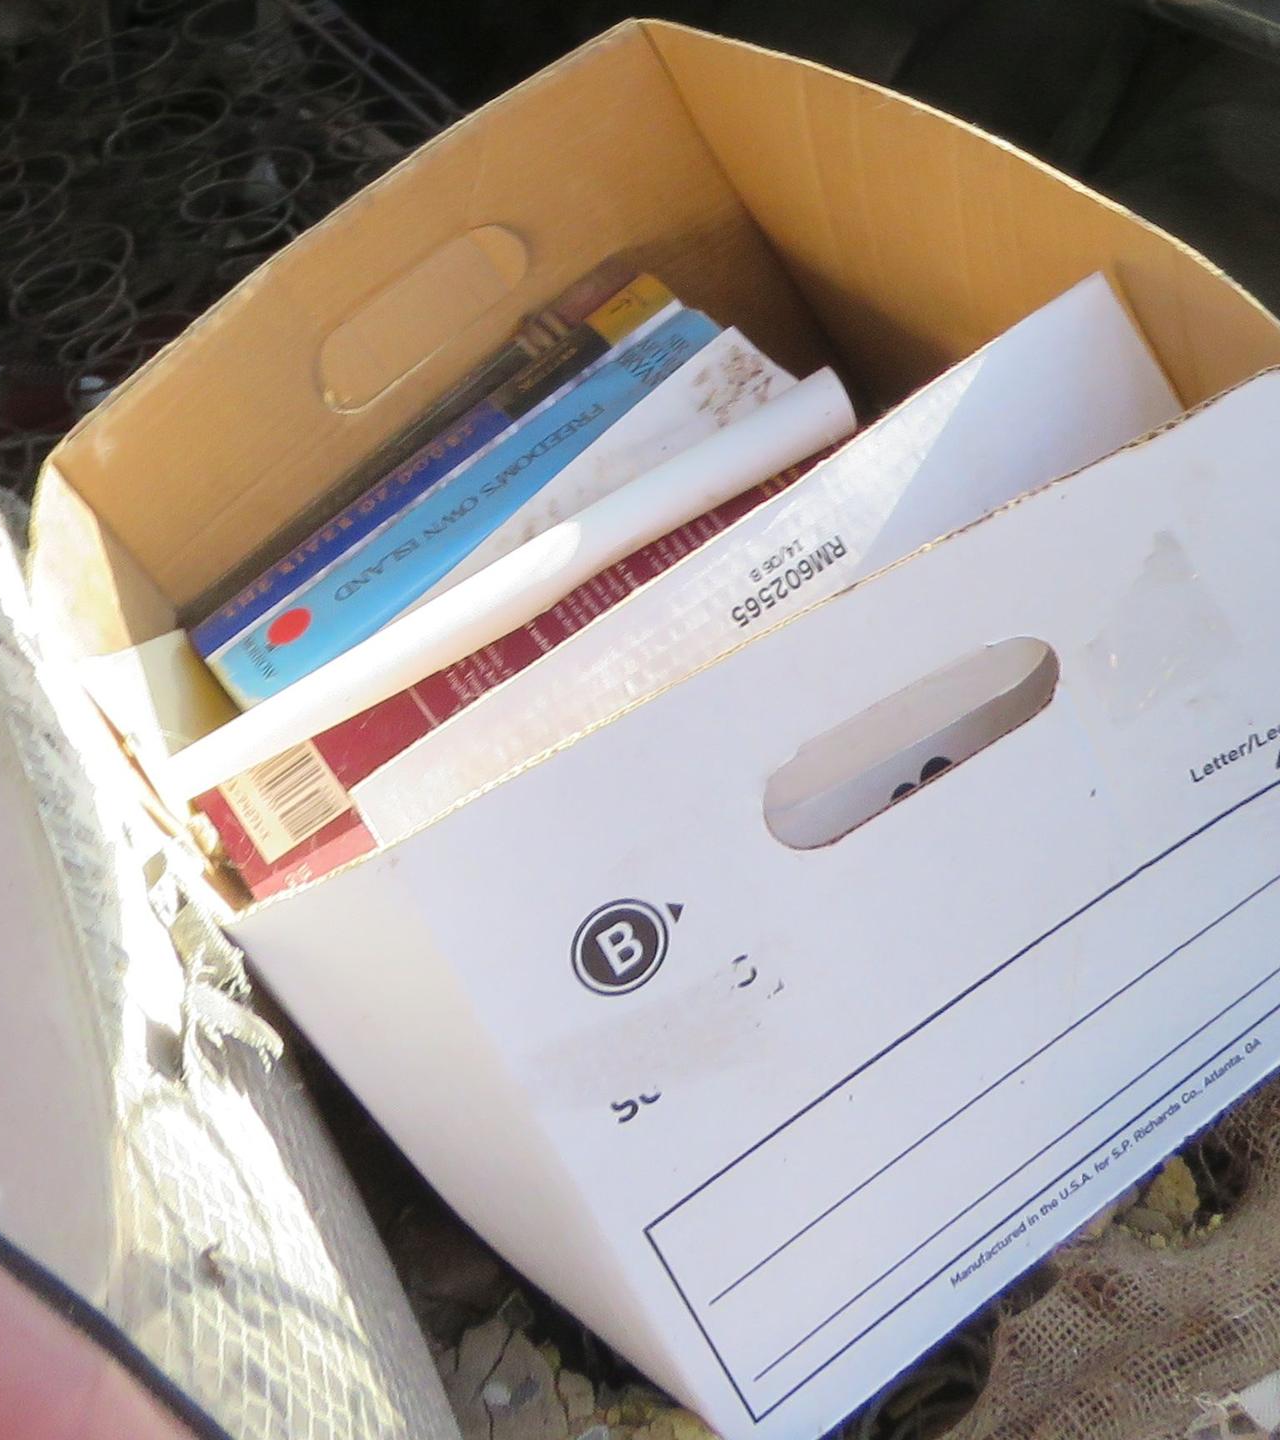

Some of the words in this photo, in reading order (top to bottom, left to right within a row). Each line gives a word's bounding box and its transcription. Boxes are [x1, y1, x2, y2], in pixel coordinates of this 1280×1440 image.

[479, 403, 606, 497] FREEDOM'S
[423, 496, 479, 541] OWN
[334, 538, 419, 601] ISLAND
[731, 535, 847, 628] RM602565
[595, 920, 644, 978] B
[950, 1221, 1027, 1289] Manufactured
[1027, 1212, 1040, 1227] in
[1039, 1198, 1059, 1216] the
[1094, 1157, 1111, 1174] for
[1111, 1139, 1133, 1160] S.P.
[1133, 1102, 1182, 1143] Richards
[1243, 1037, 1262, 1055] GA
